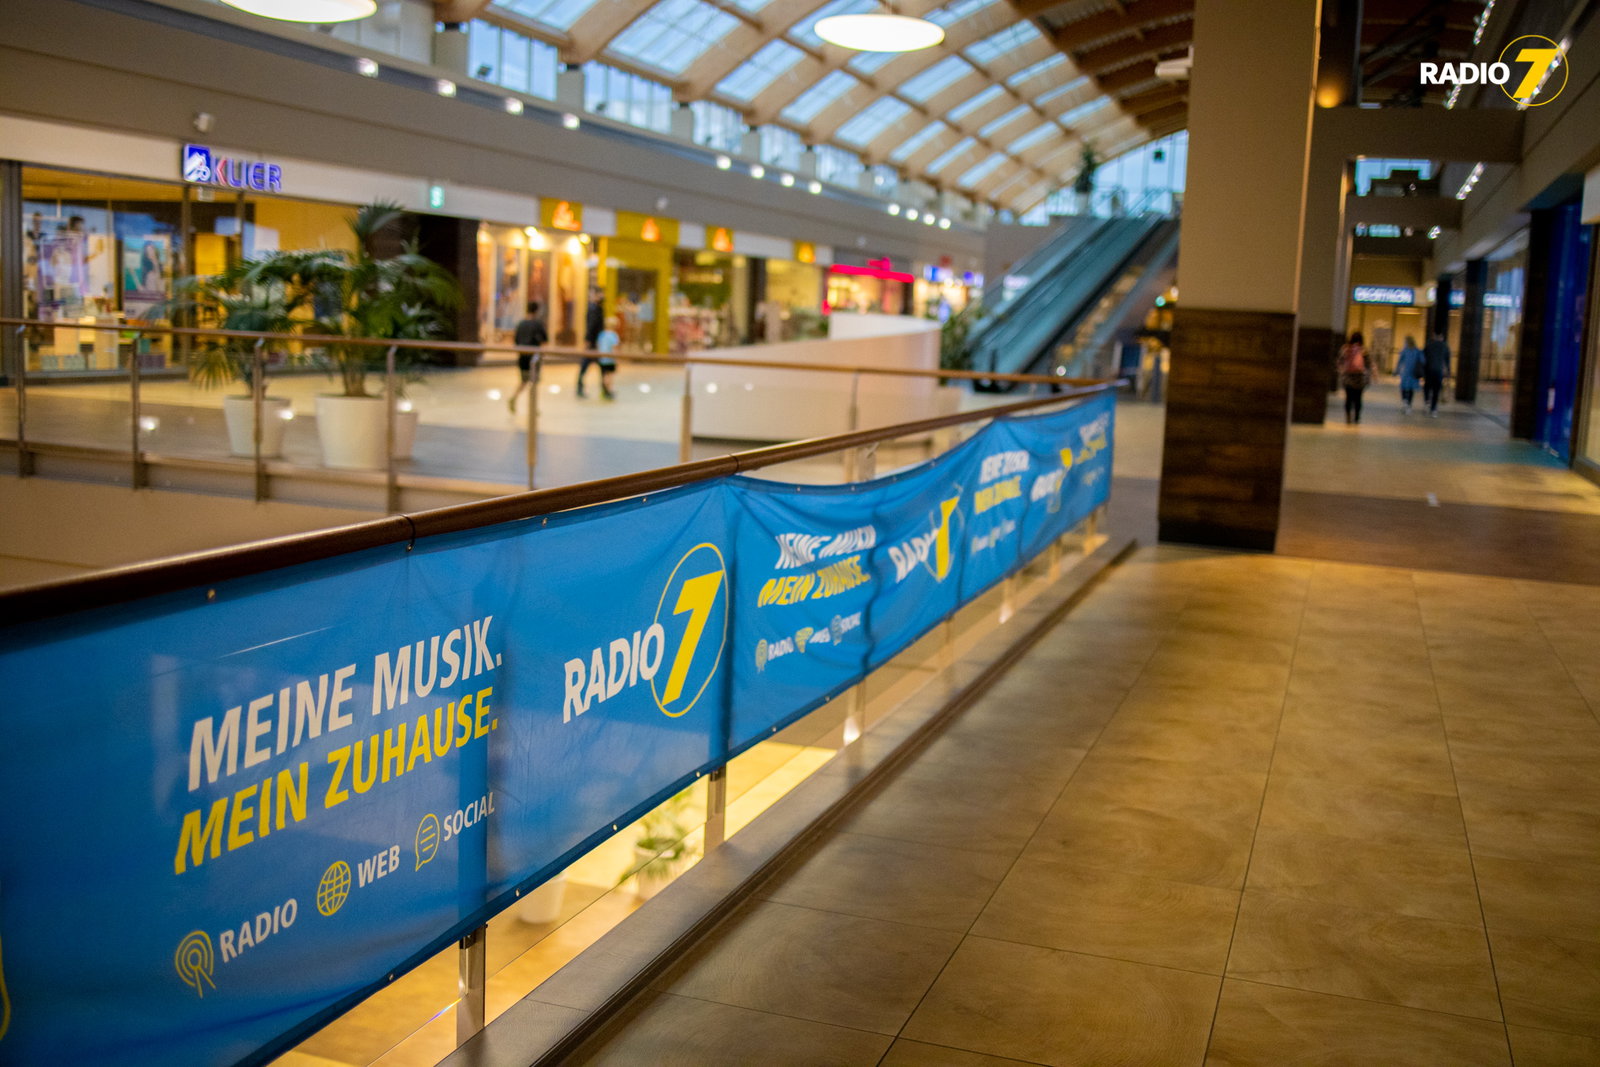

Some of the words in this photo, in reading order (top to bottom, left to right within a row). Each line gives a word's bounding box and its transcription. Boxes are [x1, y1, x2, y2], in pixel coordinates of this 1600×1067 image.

[211, 156, 281, 192] KLIER
[187, 663, 357, 792] MEINE
[371, 615, 502, 716] MUSIK.
[563, 623, 665, 724] RADIO
[661, 569, 725, 707] 7
[174, 762, 308, 875] MEIN
[324, 686, 499, 809] ZUHAUSE.
[219, 898, 298, 963] RADIO
[357, 845, 401, 888] WEB
[443, 791, 496, 842] SOCIAL
